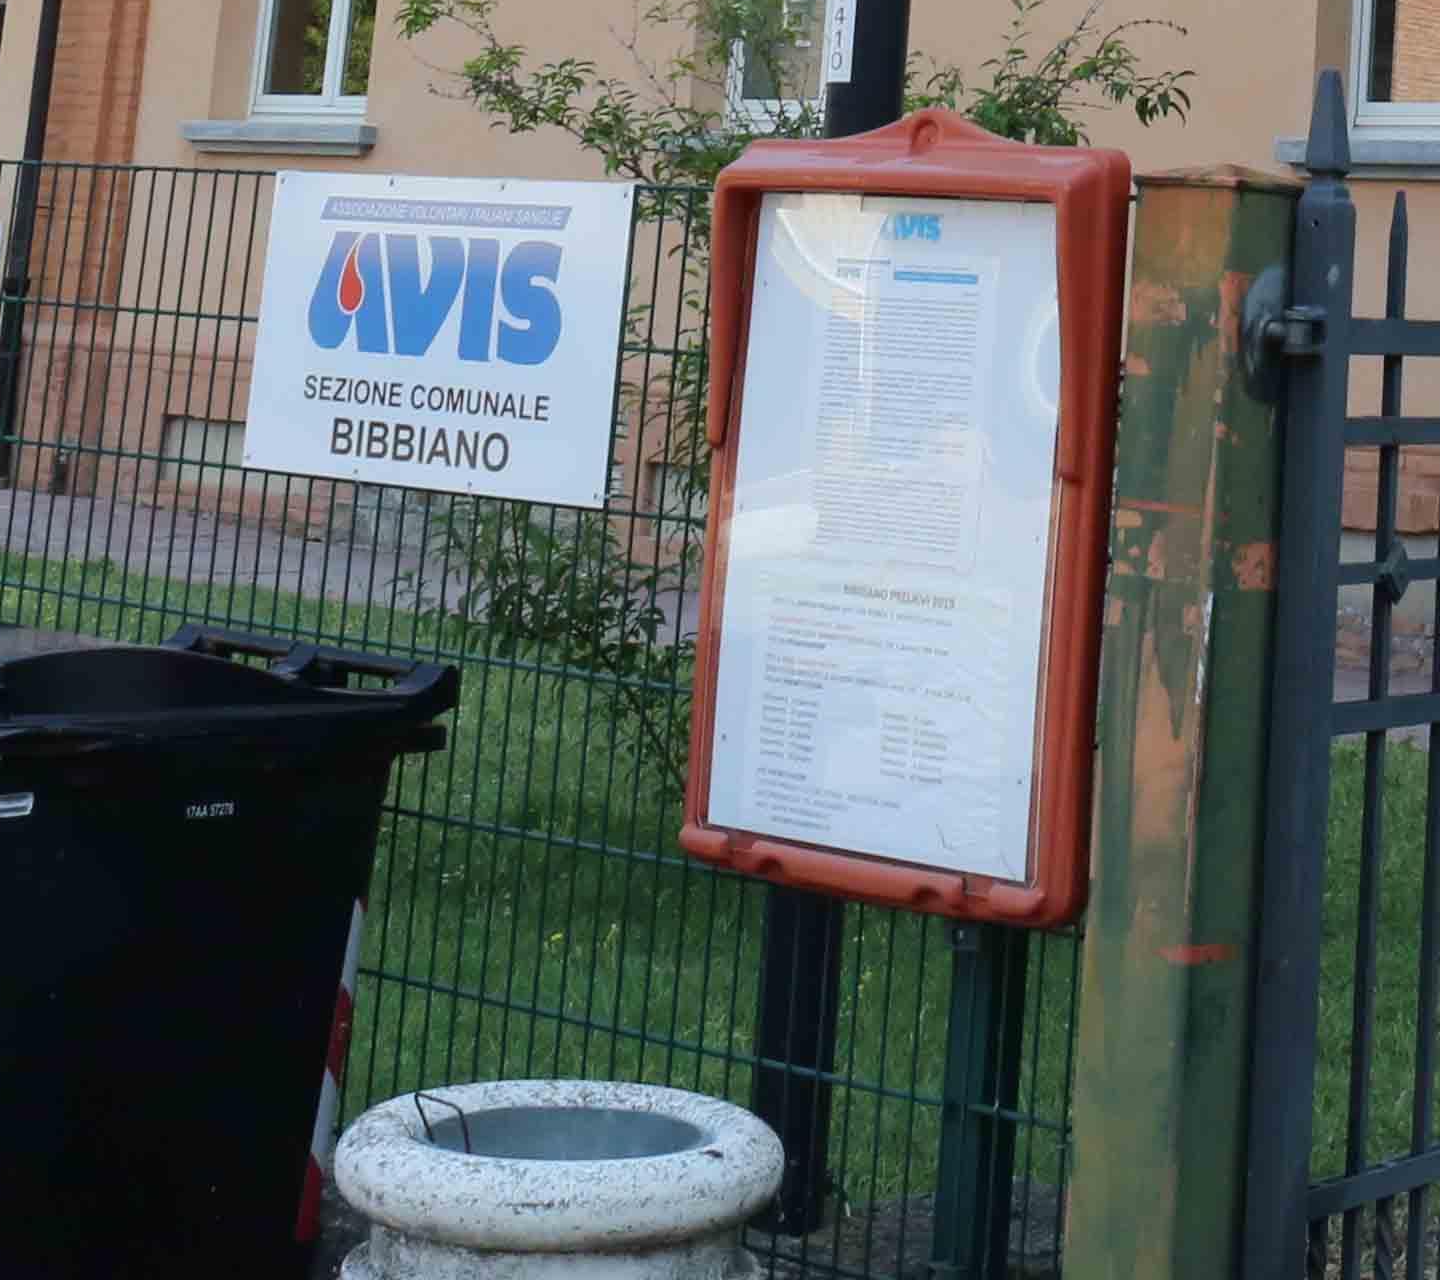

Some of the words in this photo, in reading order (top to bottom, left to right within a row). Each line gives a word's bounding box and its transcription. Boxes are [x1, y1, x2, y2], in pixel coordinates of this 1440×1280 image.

[308, 230, 563, 366] AVIS
[303, 374, 404, 408] SEZIONE
[411, 384, 551, 422] COMUNALE
[329, 416, 510, 473] BIBBIANO
